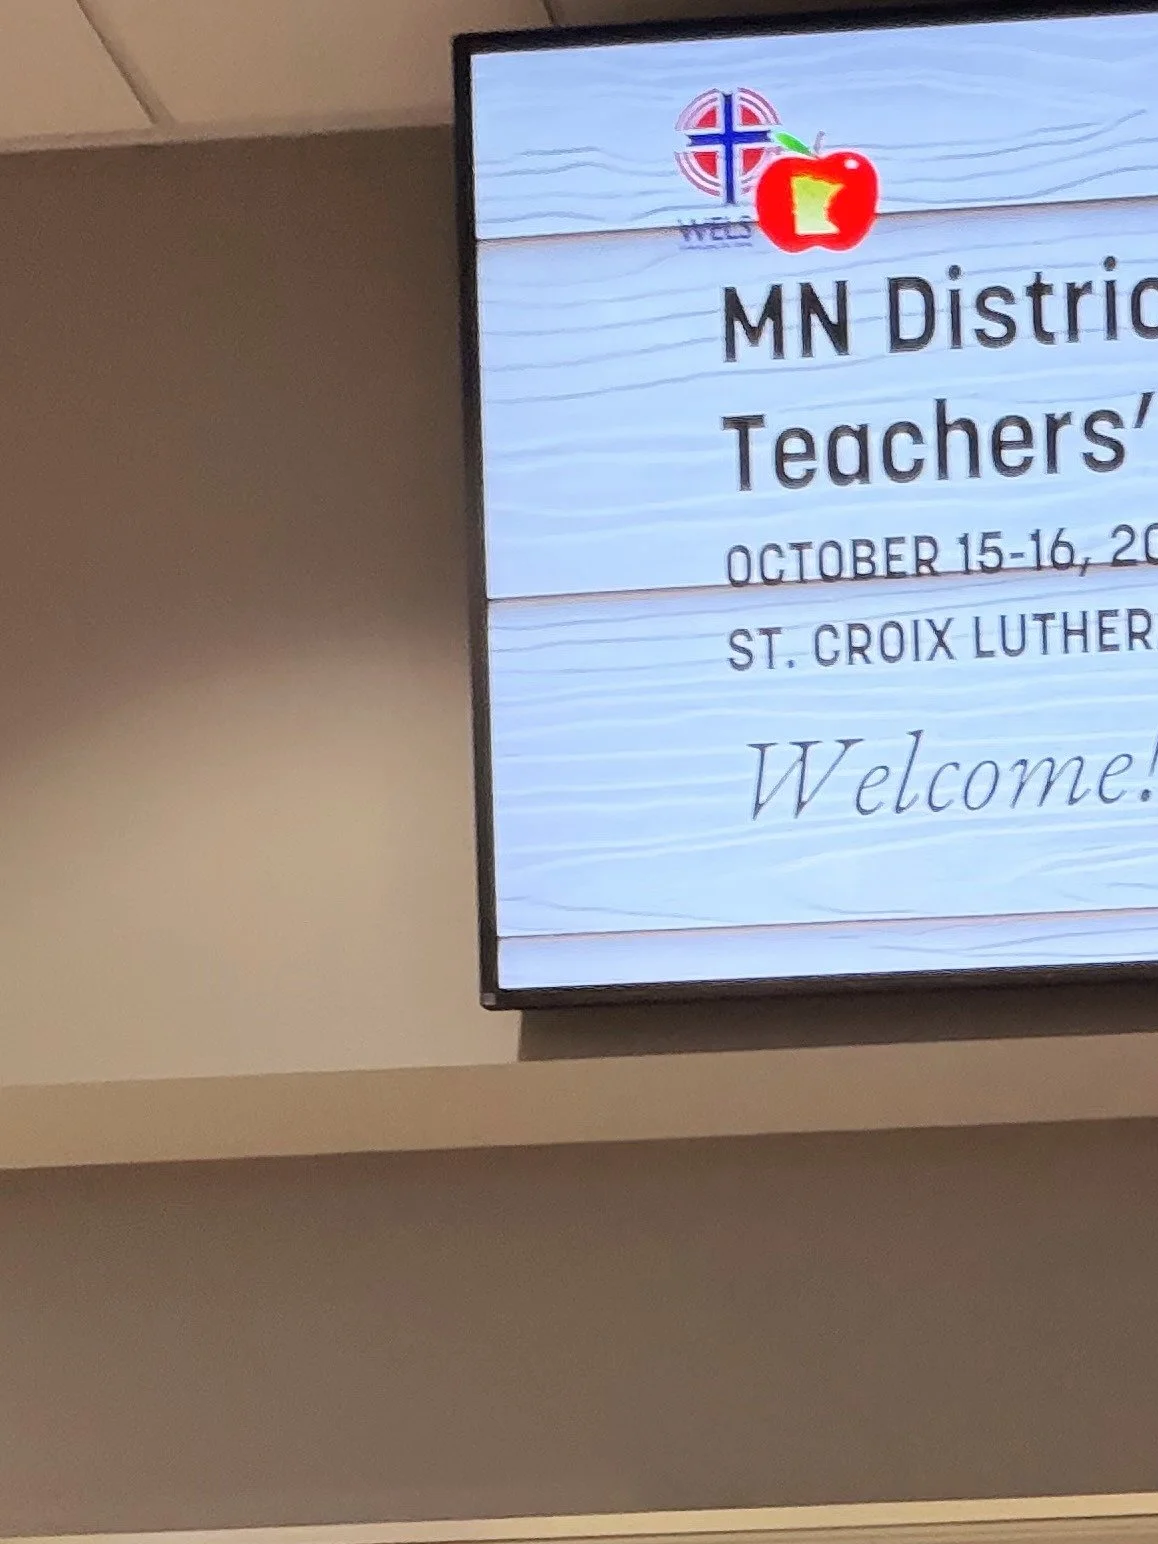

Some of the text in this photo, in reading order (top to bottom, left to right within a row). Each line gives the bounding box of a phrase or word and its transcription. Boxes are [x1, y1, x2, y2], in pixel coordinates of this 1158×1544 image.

[723, 280, 850, 363] MN
[721, 392, 1155, 491] Teachers'
[726, 535, 940, 587] OCTOBER
[957, 528, 1091, 577] 15-16,
[728, 626, 796, 671] ST.
[814, 617, 956, 667] CROIX
